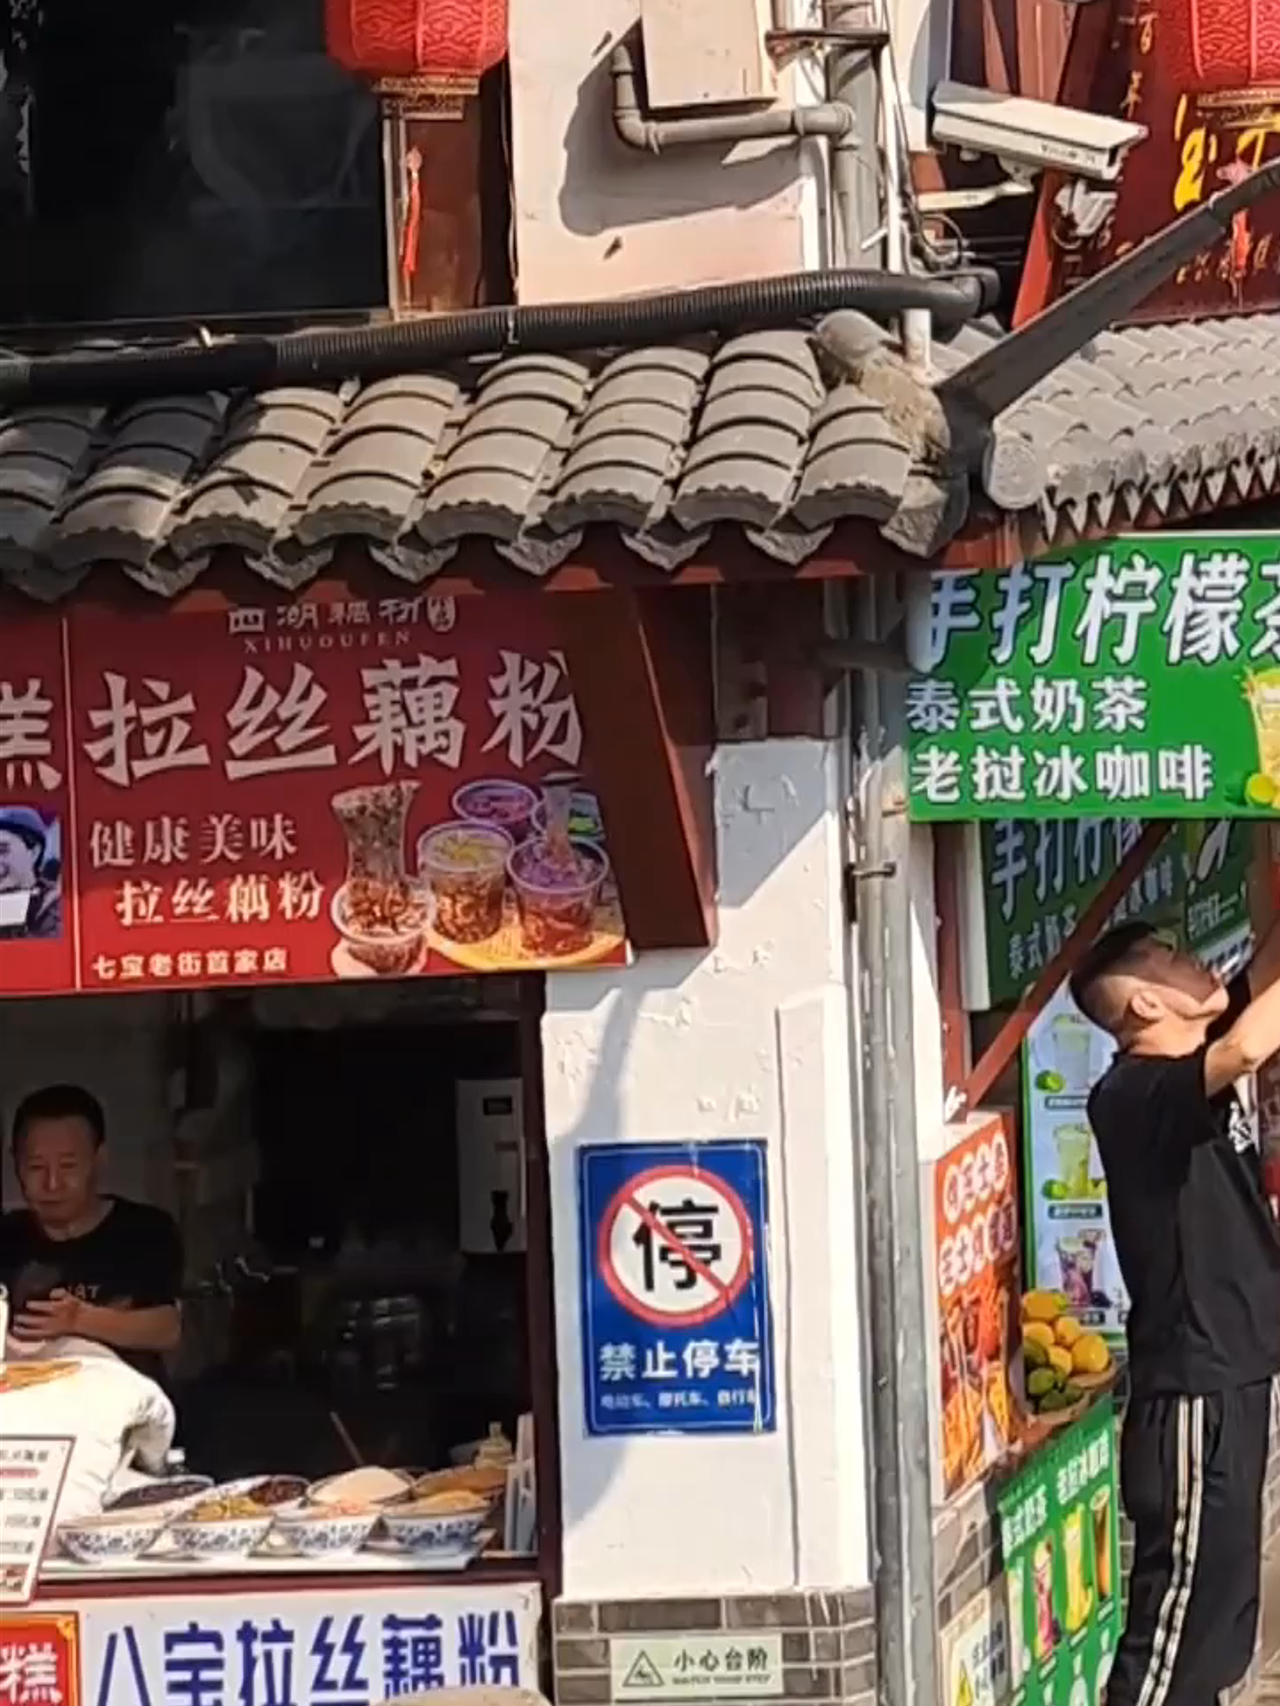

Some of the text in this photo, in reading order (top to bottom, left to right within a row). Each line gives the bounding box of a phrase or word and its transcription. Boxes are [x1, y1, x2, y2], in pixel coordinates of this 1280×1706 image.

[84, 650, 584, 787] 拉丝藕粉
[906, 675, 1148, 735] 泰式奶茶
[912, 744, 1215, 805] 老挝冰咖啡
[90, 813, 298, 867] 健康美味
[115, 871, 325, 927] 拉丝藕粉
[92, 947, 289, 979] 七宝老街首家店
[632, 1197, 722, 1293] 停
[599, 1338, 760, 1382] 禁止停车
[673, 1646, 769, 1673] 小心台阶
